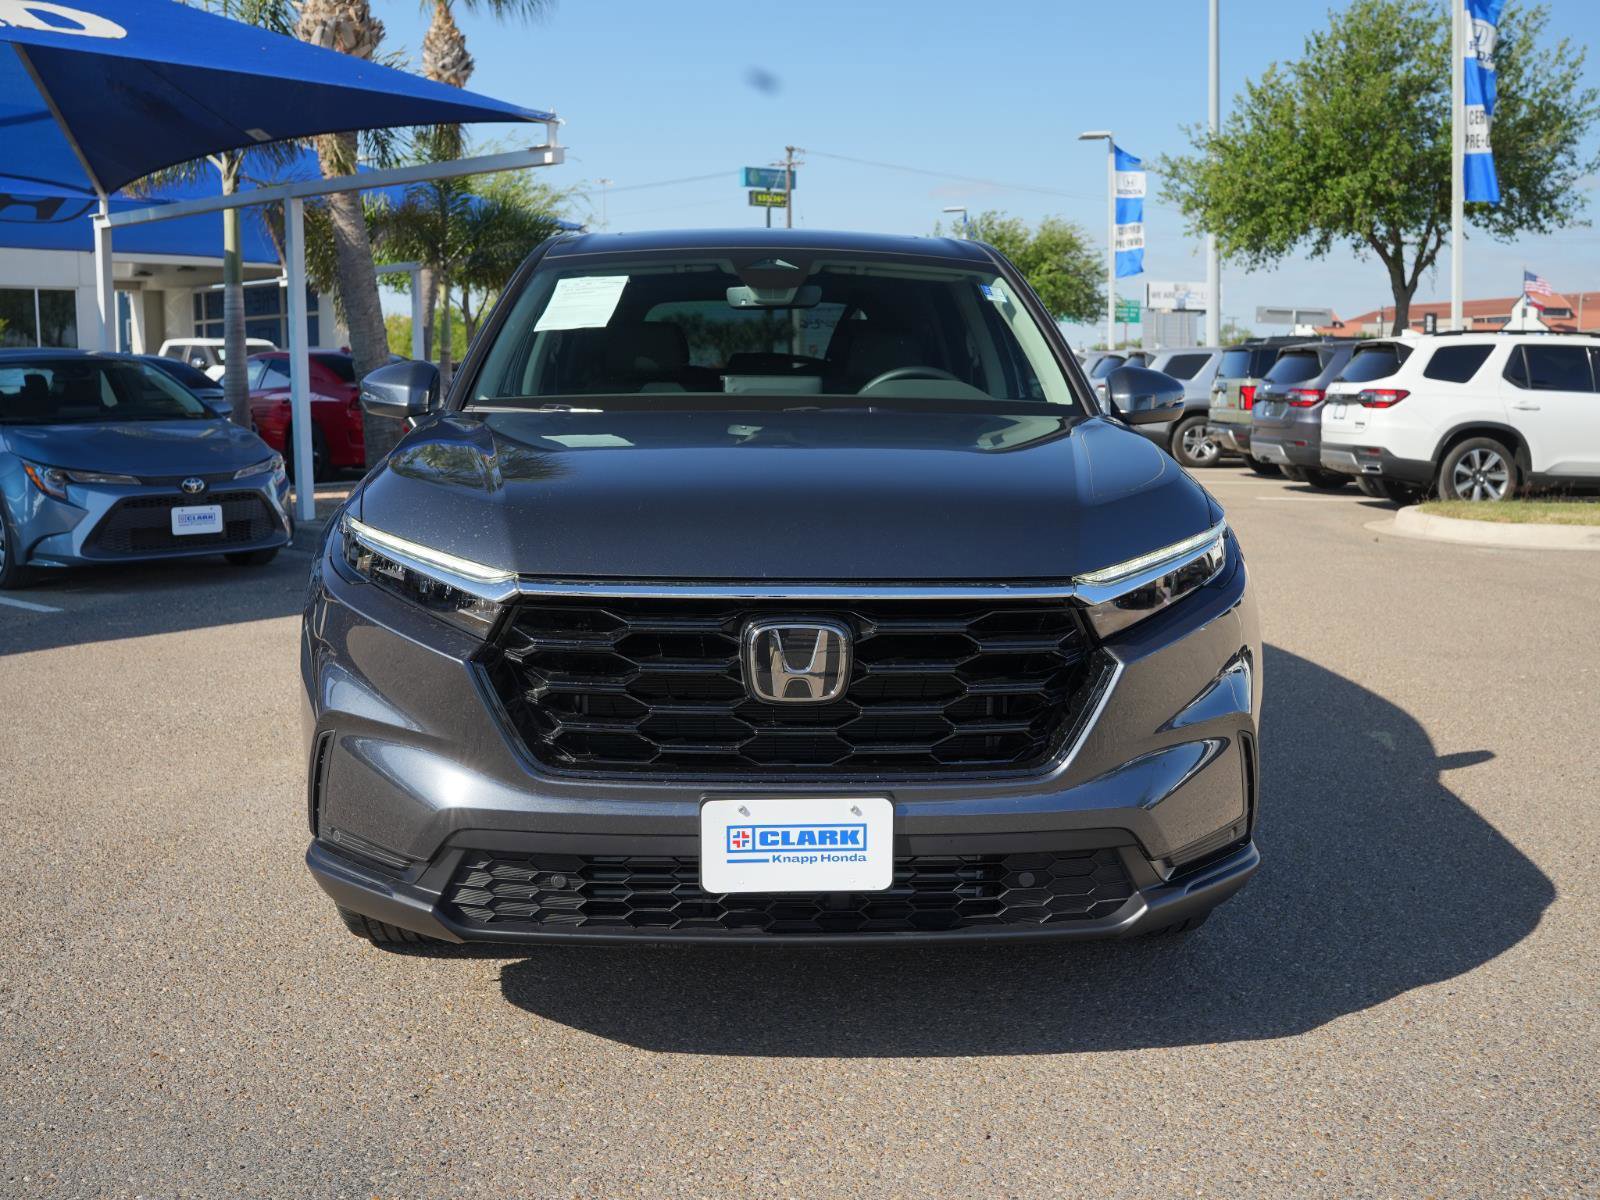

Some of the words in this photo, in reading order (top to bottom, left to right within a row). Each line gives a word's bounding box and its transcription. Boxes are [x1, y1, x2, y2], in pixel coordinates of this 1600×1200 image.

[759, 830, 860, 846] CLARK
[772, 855, 818, 864] Knapp
[820, 854, 867, 863] Honda
